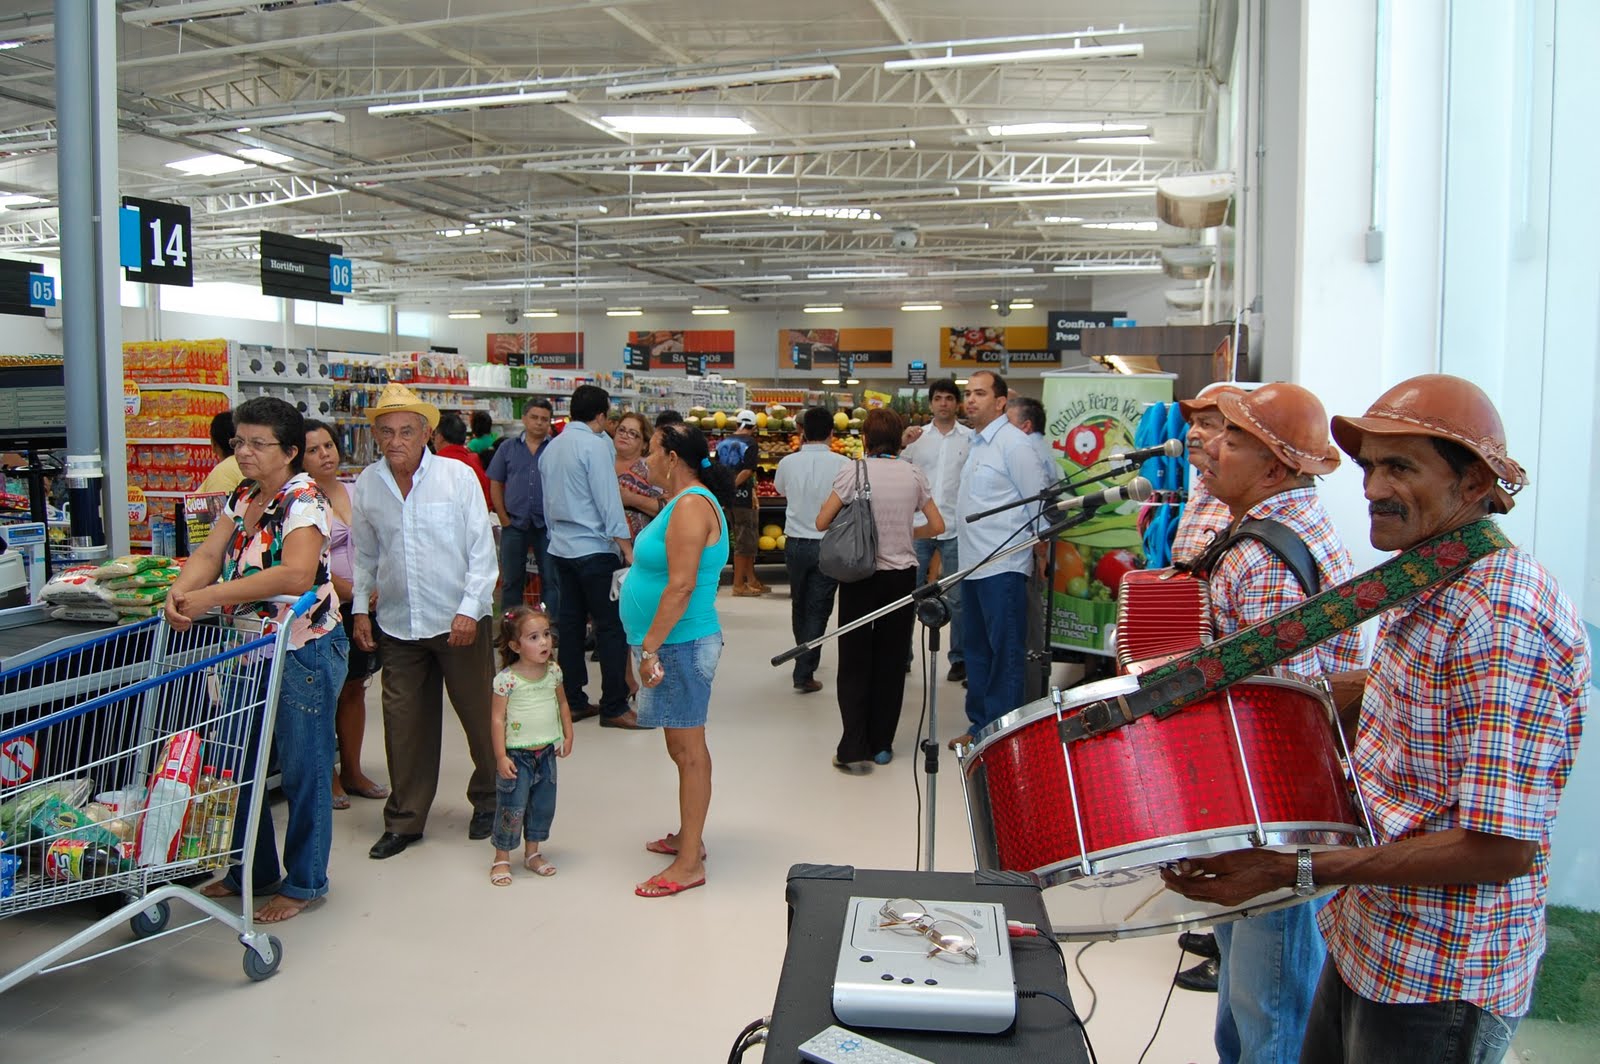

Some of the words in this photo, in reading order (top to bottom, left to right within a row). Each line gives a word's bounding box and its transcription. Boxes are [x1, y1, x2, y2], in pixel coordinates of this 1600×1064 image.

[150, 218, 187, 268] 14
[270, 259, 305, 274] Hortifruti
[332, 265, 349, 286] 06
[33, 280, 52, 300] 05
[1058, 319, 1096, 328] Confira
[1056, 332, 1080, 341] Peso
[532, 354, 566, 364] CARNES
[672, 354, 721, 363] SADOS
[982, 352, 1056, 362] COEITARIA
[1122, 398, 1144, 422] Ver
[1071, 620, 1098, 634] horta
